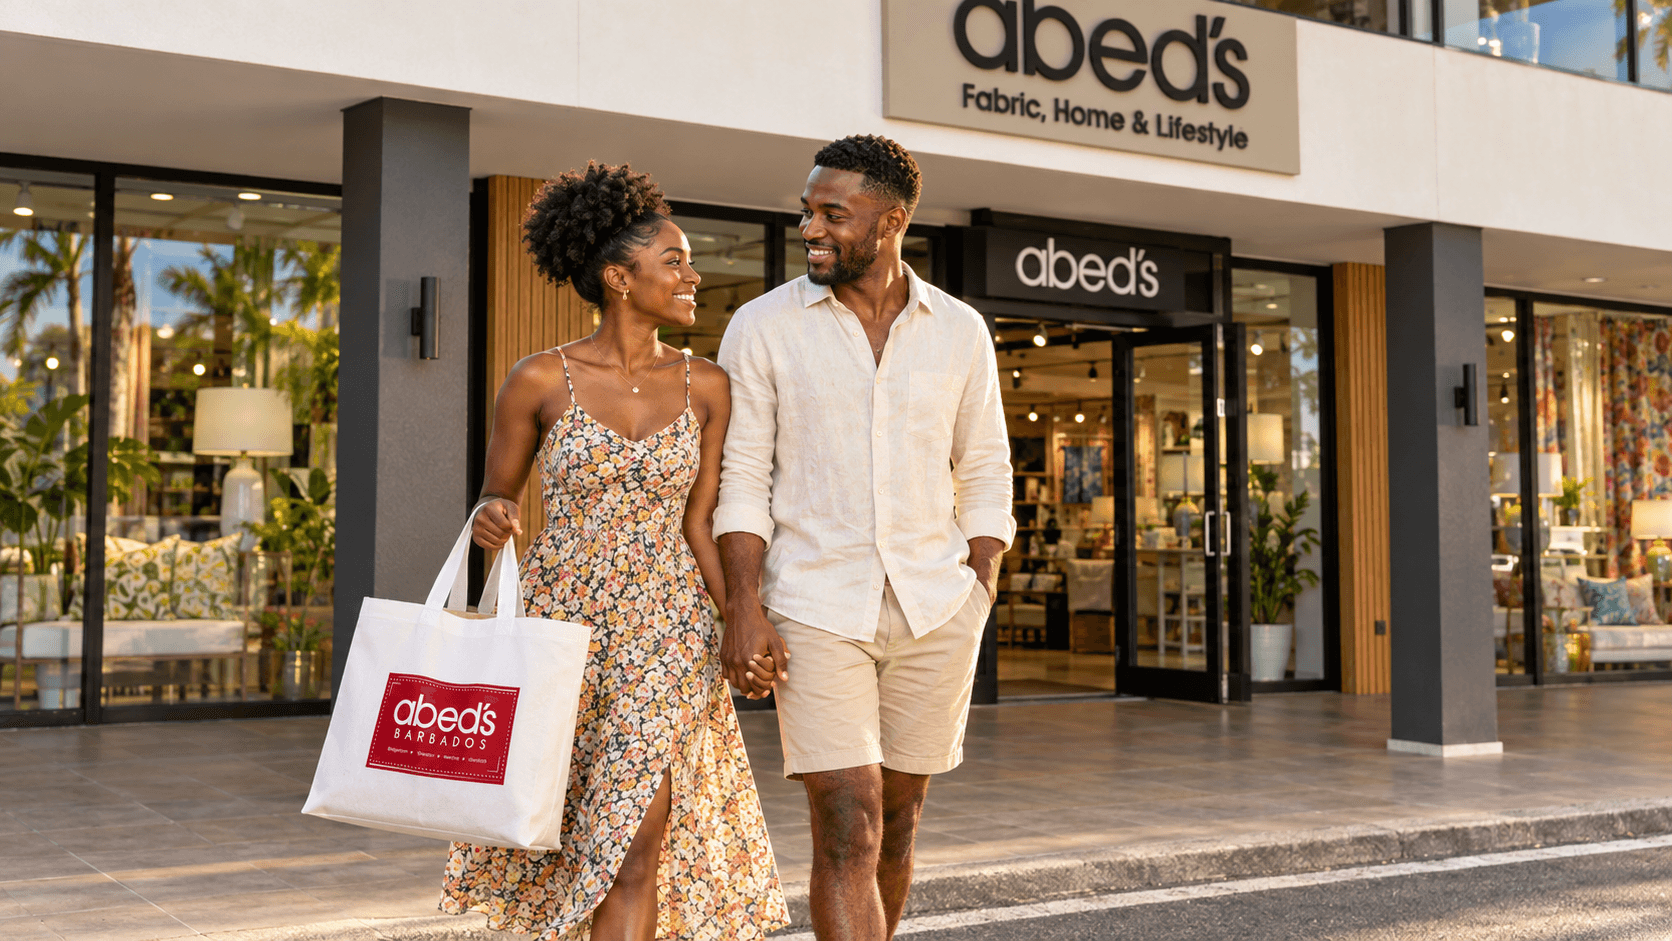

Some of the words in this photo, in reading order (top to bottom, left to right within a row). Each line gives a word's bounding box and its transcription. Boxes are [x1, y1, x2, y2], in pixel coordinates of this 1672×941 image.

[954, 0, 1250, 109] abed's
[962, 83, 1046, 123] Fabric,
[1054, 98, 1125, 131] Home
[1132, 110, 1149, 135] &
[1156, 114, 1248, 151] Lifestyle
[1015, 237, 1159, 298] abed's
[394, 694, 497, 736] abed's
[394, 728, 487, 750] BARBADOS
